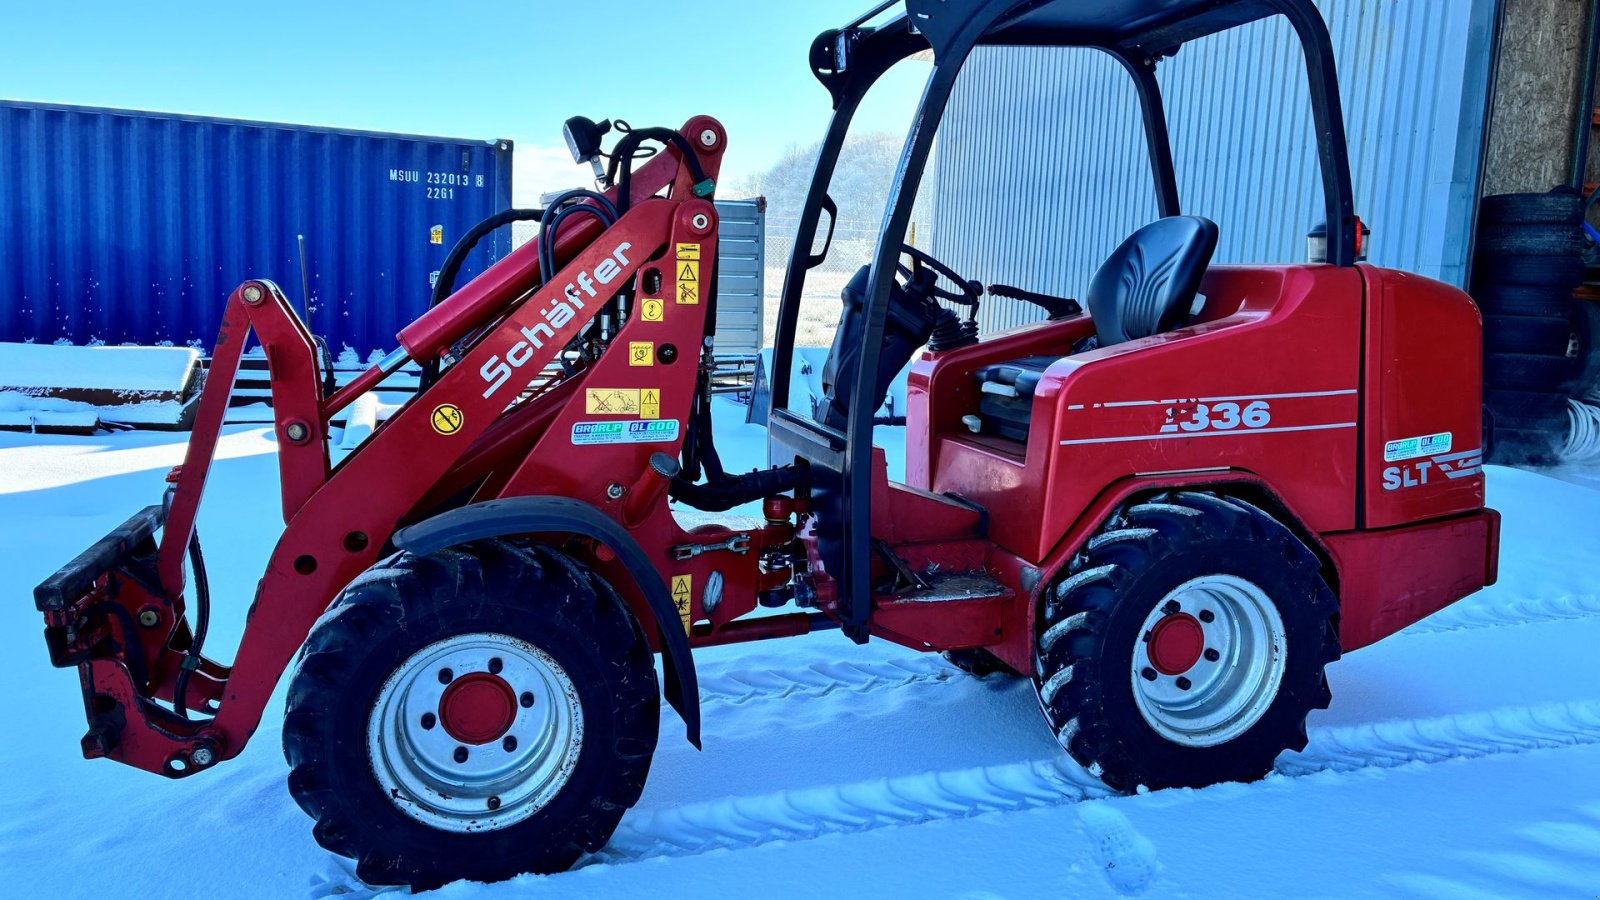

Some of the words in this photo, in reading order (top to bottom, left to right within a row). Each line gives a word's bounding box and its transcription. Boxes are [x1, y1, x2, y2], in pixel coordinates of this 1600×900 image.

[389, 169, 419, 183] MSUU
[427, 172, 469, 186] 232013
[476, 175, 484, 187] 8
[426, 187, 454, 200] 22G1
[479, 241, 632, 399] Schäffer
[1382, 461, 1432, 491] SLT
